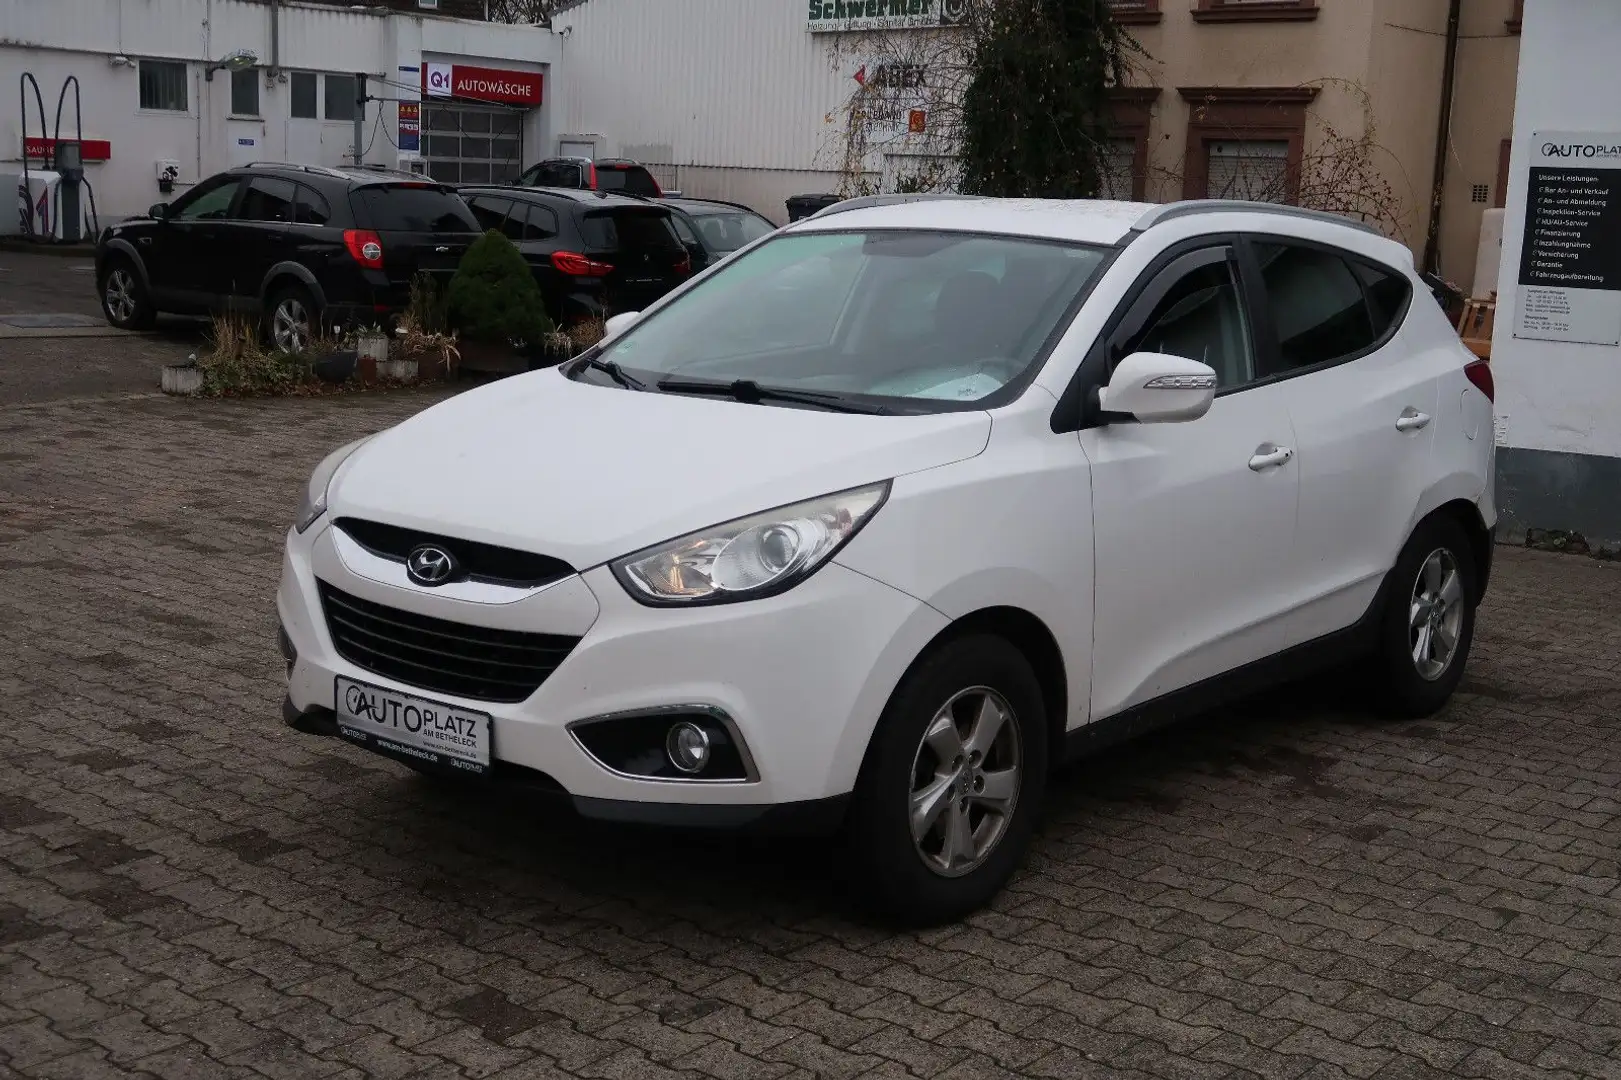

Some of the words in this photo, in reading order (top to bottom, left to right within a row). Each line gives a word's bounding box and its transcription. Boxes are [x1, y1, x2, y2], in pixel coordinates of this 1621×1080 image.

[808, 0, 929, 20] Schwermer
[430, 71, 450, 89] Q1
[457, 79, 532, 97] AUTOWÄSCHE
[1538, 174, 1562, 182] Unsere
[1570, 187, 1583, 195] und
[1584, 188, 1609, 196] Verkauf
[1570, 199, 1607, 207] Abmeldung
[1542, 208, 1601, 217] Inspektion-Service
[1541, 218, 1588, 227] HU/AU-Service
[1539, 229, 1581, 239] Finanzierung
[1538, 239, 1591, 249] Inzahlungnahme
[1537, 250, 1579, 260] Versicherung
[1536, 260, 1563, 269] Garantie
[1535, 270, 1604, 283] Fahrzeugaufbereitung
[423, 728, 434, 738] AM
[435, 732, 477, 749] BETHELECK
[377, 739, 438, 763] www.am-betheleck.de
